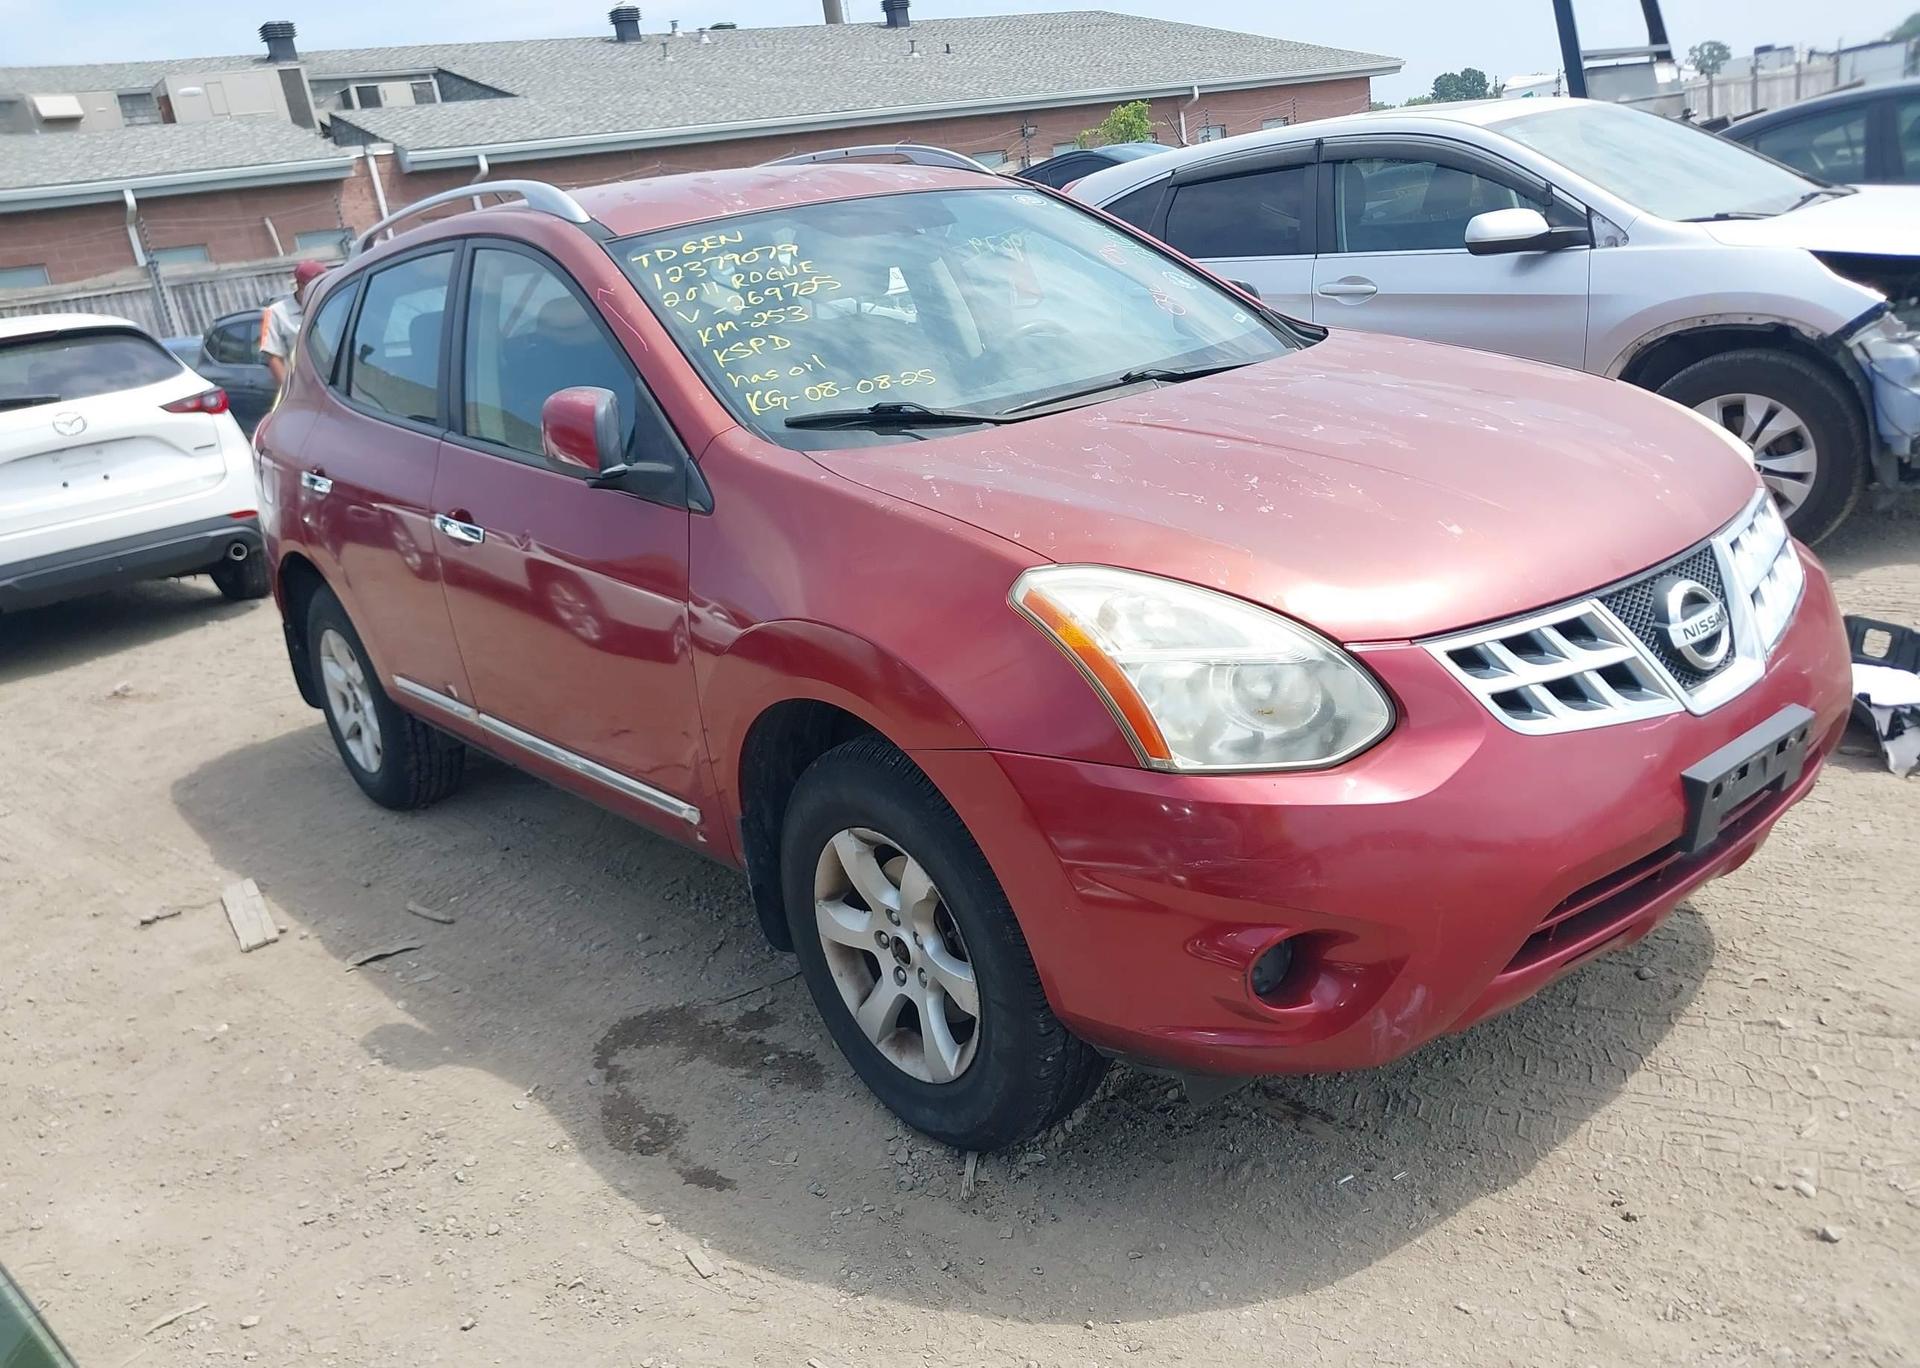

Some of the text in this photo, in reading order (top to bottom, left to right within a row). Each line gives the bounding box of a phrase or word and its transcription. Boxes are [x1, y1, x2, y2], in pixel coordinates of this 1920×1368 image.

[653, 244, 799, 290] 12379079
[663, 282, 719, 308] 2011
[727, 368, 780, 388] has
